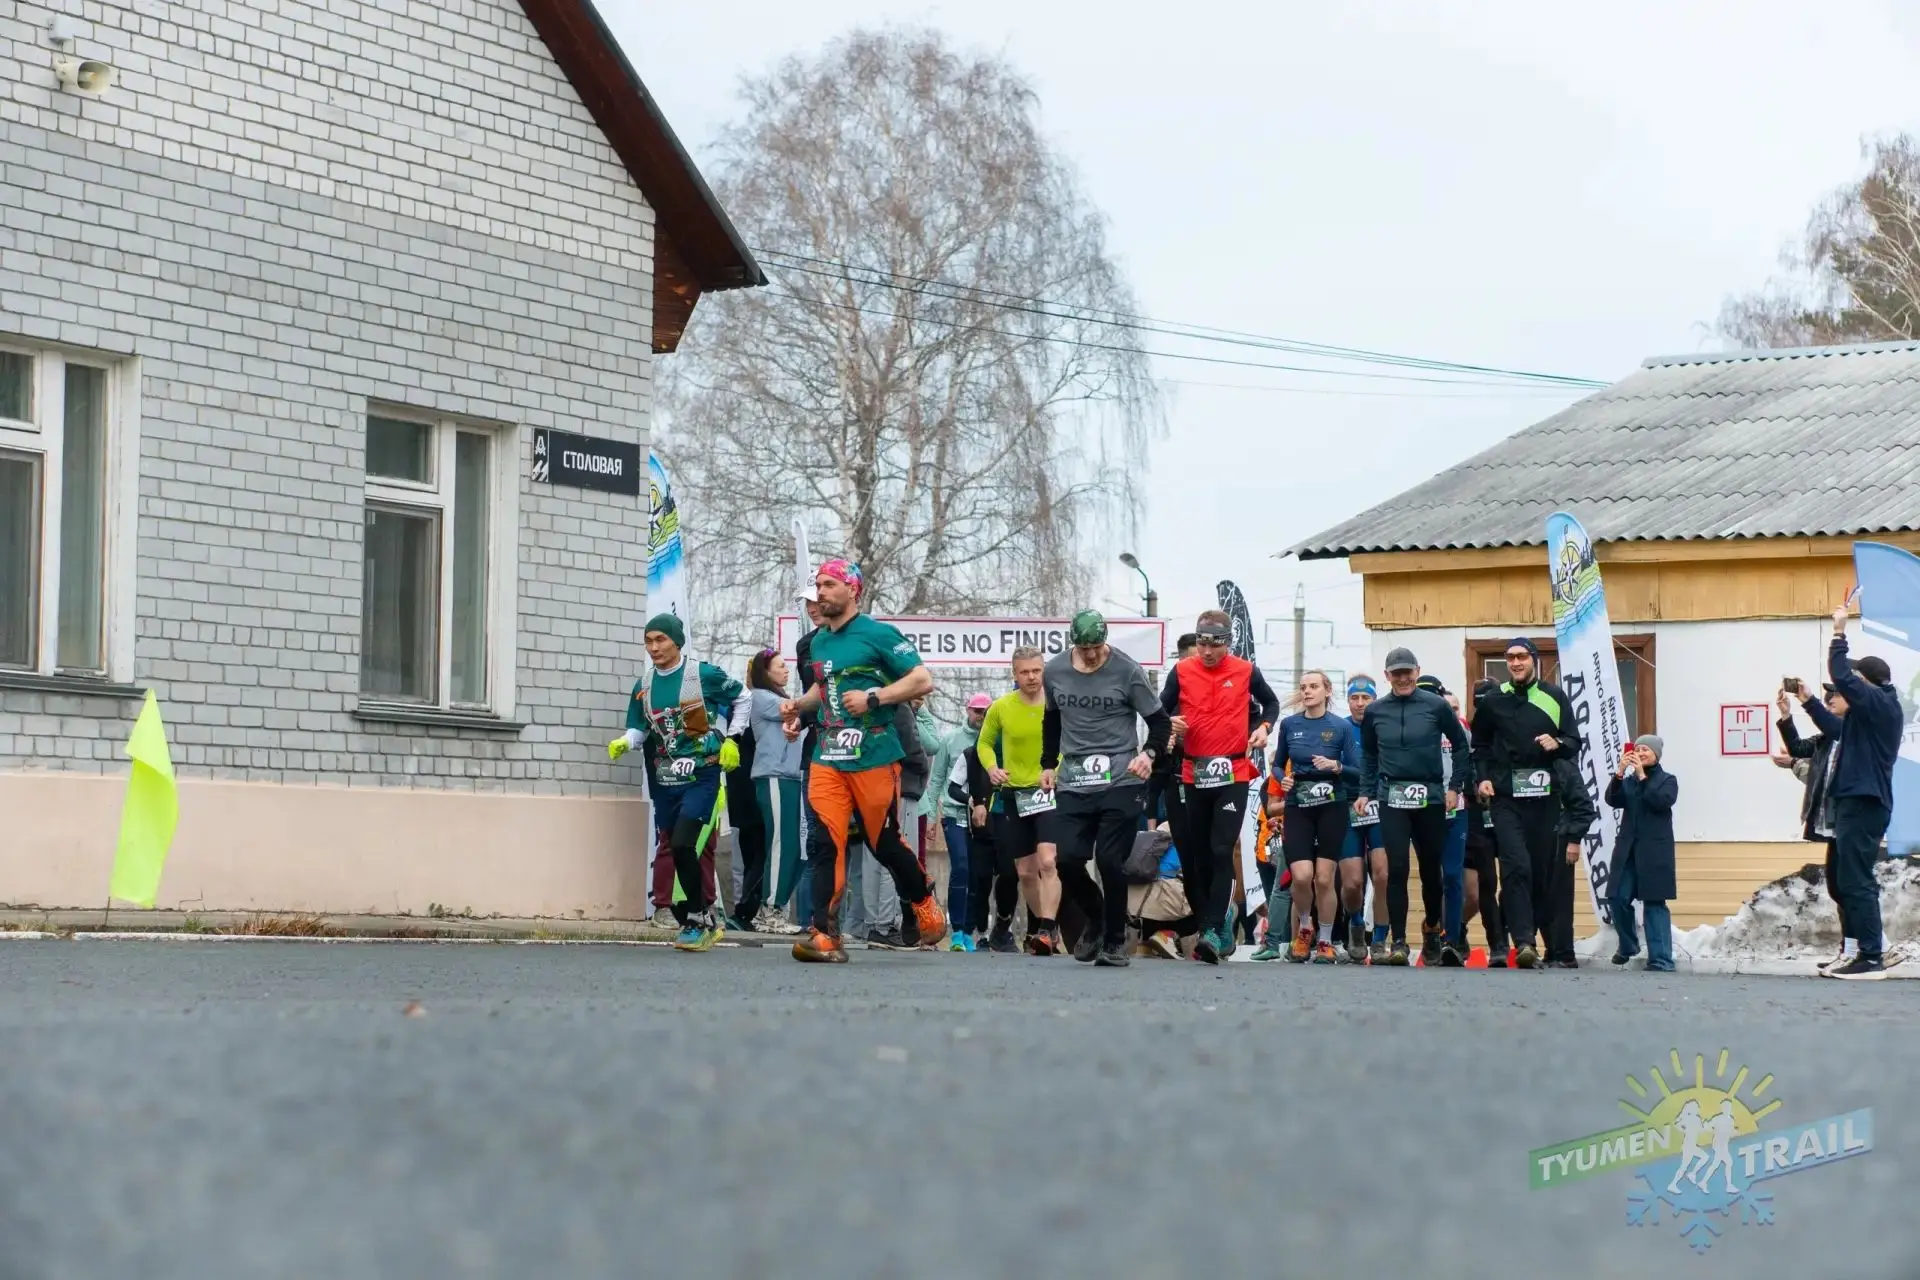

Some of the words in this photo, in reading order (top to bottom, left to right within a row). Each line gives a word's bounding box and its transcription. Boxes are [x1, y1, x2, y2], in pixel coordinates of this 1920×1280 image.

[563, 450, 623, 477] СТОЛОВАЯ
[938, 634, 956, 652] IS
[962, 634, 992, 653] NO
[1058, 693, 1114, 710] CROPP
[1736, 710, 1754, 724] ПГ
[842, 733, 860, 748] 20
[676, 761, 694, 774] 30
[1092, 758, 1101, 773] 6
[1211, 762, 1230, 776] 28
[1537, 773, 1544, 787] 7
[1317, 786, 1330, 797] 12
[1409, 787, 1425, 800] 25
